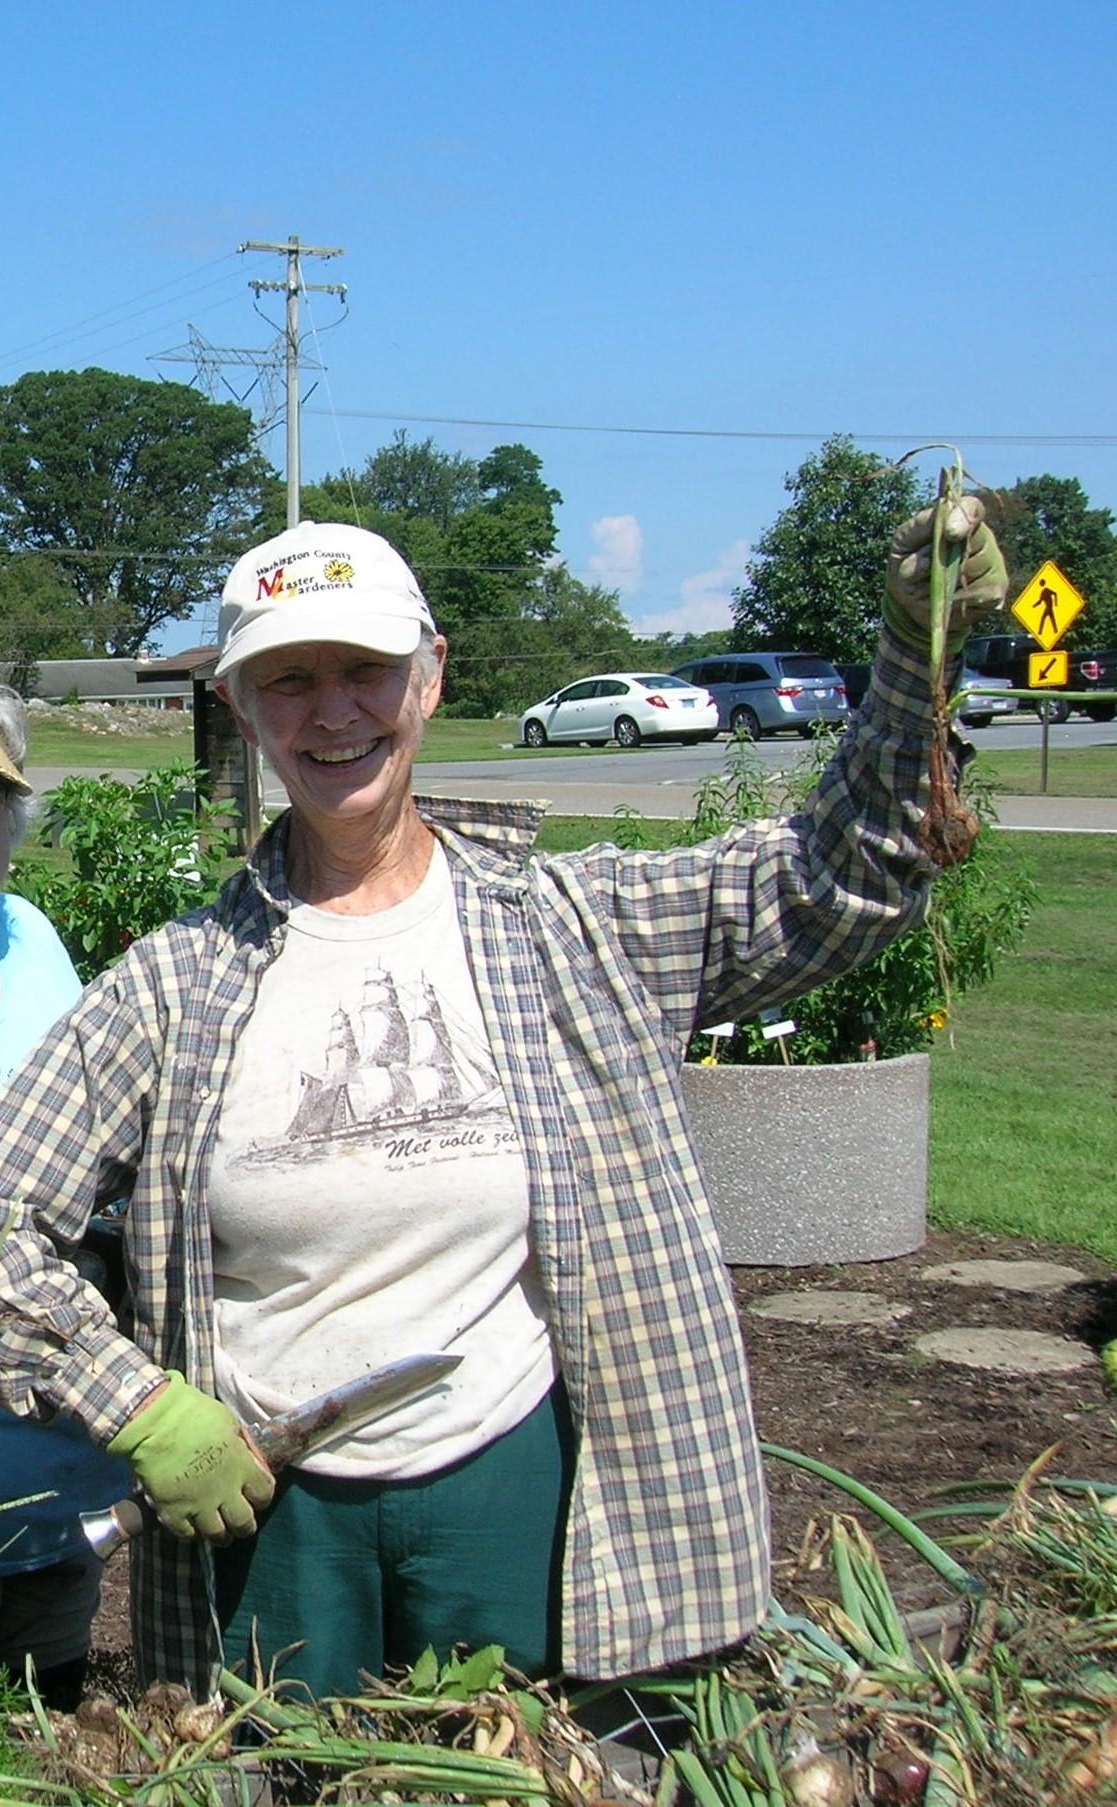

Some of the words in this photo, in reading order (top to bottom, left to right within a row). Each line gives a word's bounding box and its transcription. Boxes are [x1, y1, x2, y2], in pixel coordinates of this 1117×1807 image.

[256, 551, 310, 576] Washington
[314, 549, 351, 561] County
[256, 568, 315, 601] Master
[385, 1138, 432, 1159] Met
[440, 1130, 485, 1149] volle
